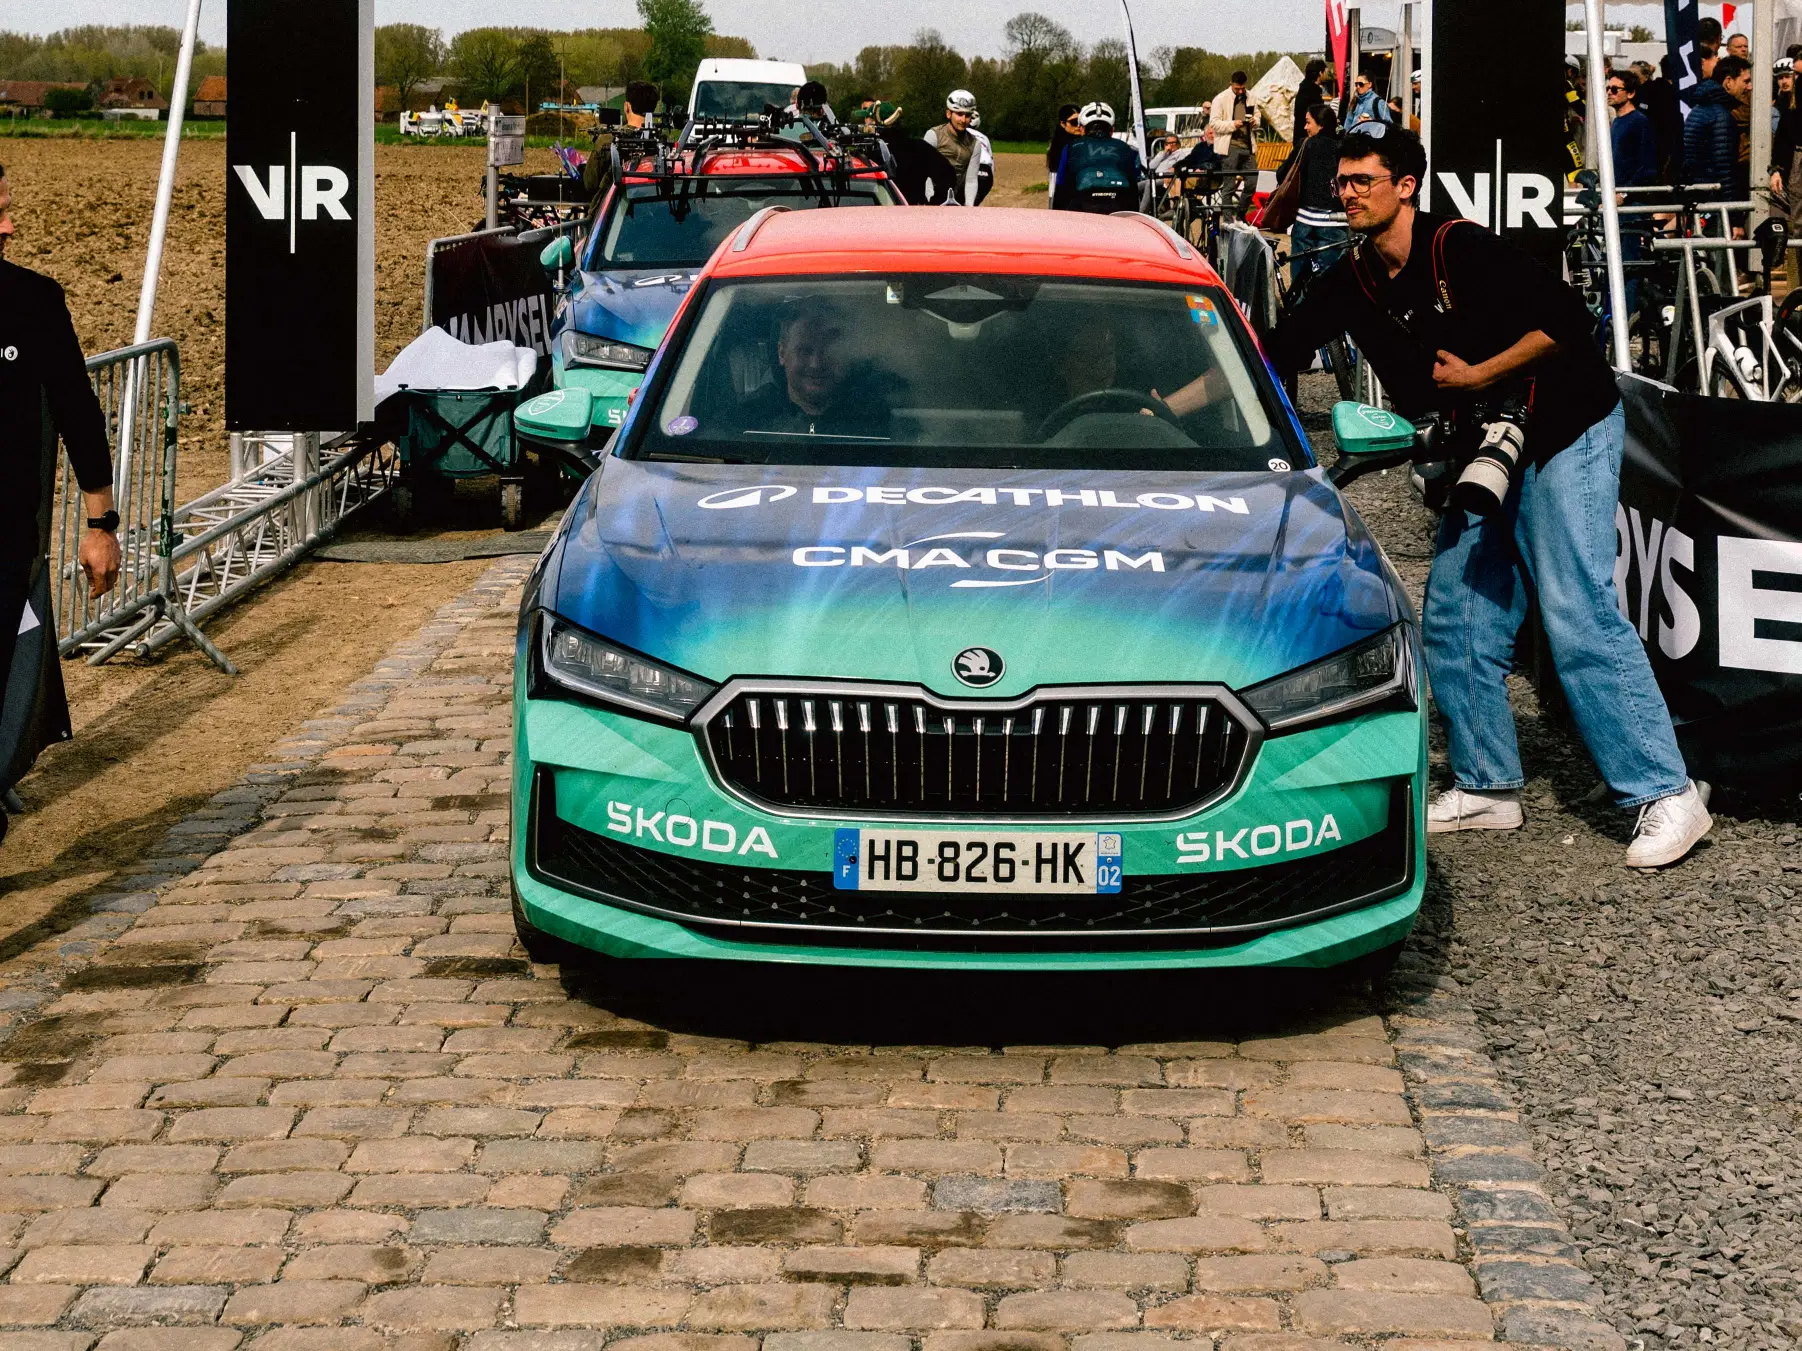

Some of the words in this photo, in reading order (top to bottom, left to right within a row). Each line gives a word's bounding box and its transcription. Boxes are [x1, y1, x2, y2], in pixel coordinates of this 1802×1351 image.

[1439, 279, 1452, 310] Canon
[1270, 461, 1288, 471] 20
[812, 487, 1250, 515] DECATHLON
[792, 546, 971, 569] CMA
[985, 548, 1167, 573] CGM
[842, 864, 851, 878] F
[867, 838, 1085, 884] HB-826-HK
[1097, 865, 1121, 887] 02
